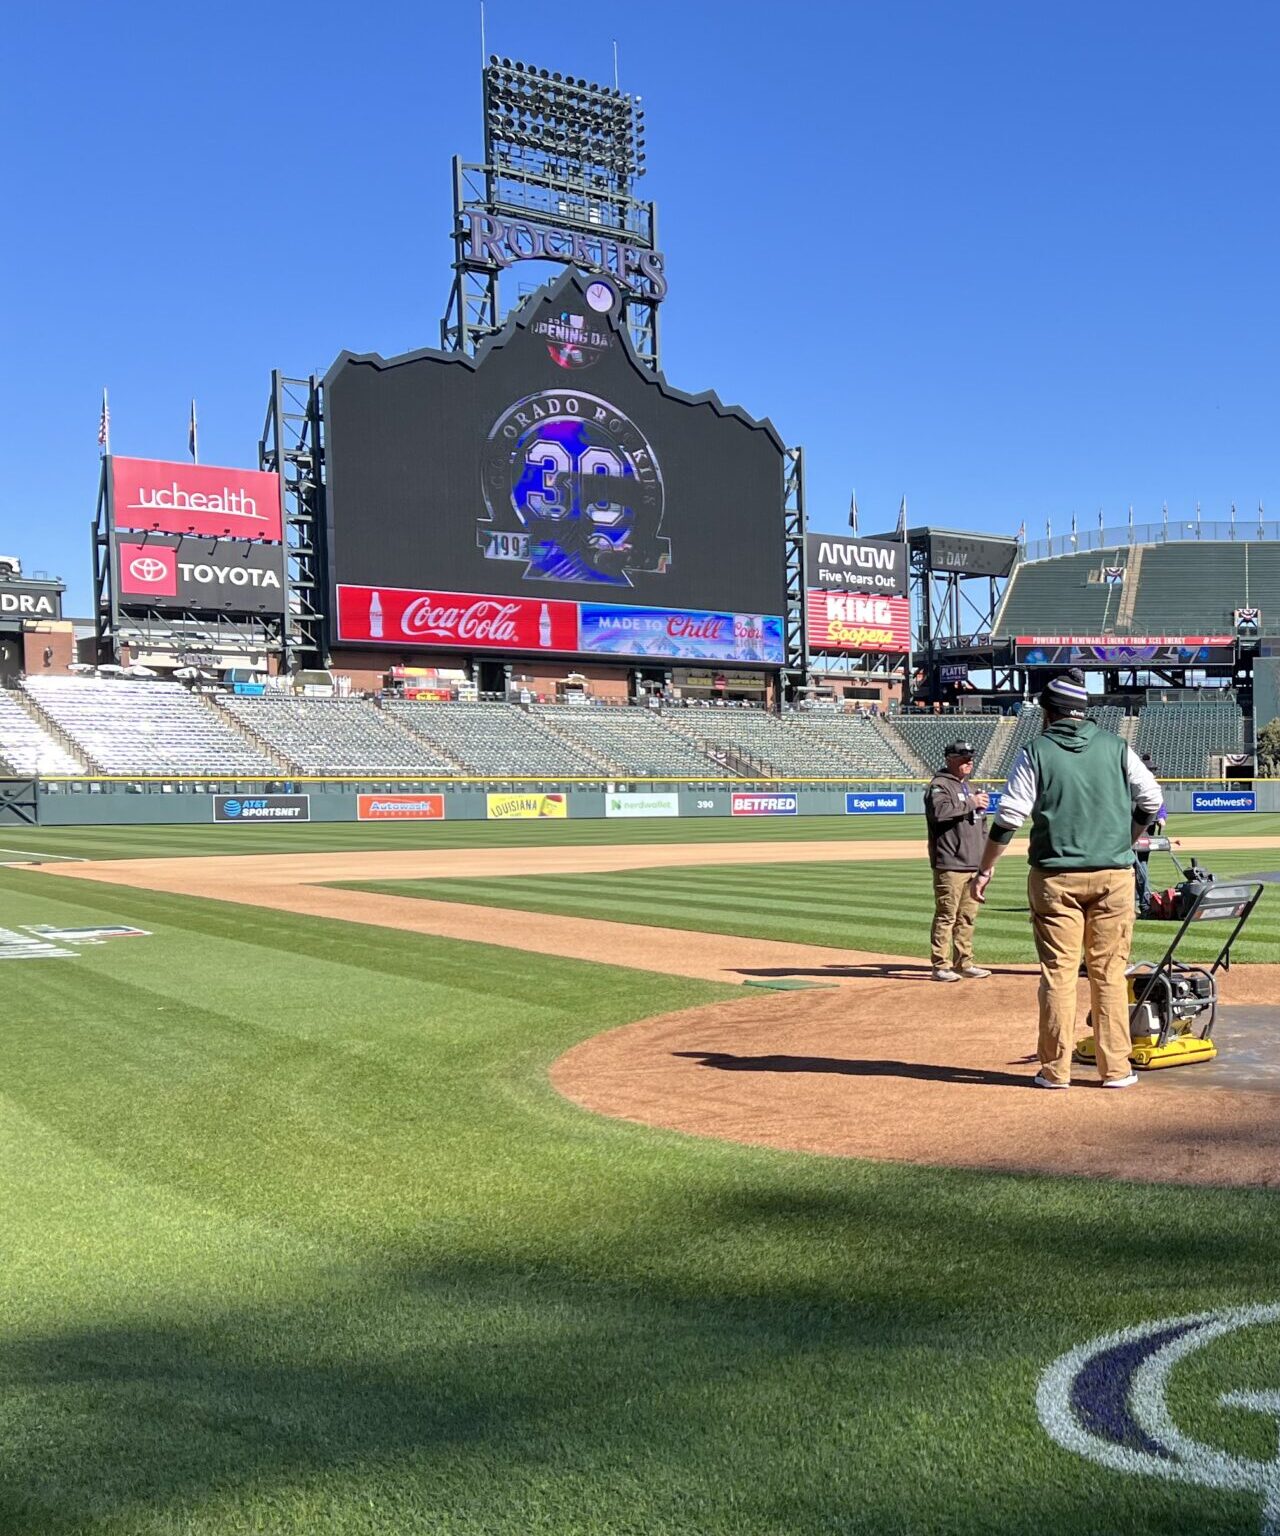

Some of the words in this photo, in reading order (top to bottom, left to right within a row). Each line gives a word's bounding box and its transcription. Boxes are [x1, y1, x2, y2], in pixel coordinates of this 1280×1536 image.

[464, 208, 668, 301] ROCKIES
[138, 482, 257, 517] uchealth
[817, 542, 896, 570] ARROW
[178, 562, 281, 589] TOYOTA
[819, 569, 843, 583] Five
[843, 571, 874, 586] Years
[876, 574, 896, 588] Out
[1, 593, 53, 613] DRA
[826, 597, 892, 624] KING
[401, 597, 522, 642] Coca-Cola
[598, 615, 641, 630] MADE
[646, 618, 663, 632] TO
[665, 614, 724, 640] Chill
[826, 620, 894, 647] Soopers
[941, 666, 967, 676] PLATTE
[241, 807, 301, 817] SPORTSNET
[242, 800, 268, 808] AT&T
[370, 801, 430, 811] Autowash
[490, 799, 538, 818] LOUISIANA
[624, 800, 673, 810] nerdwallet
[697, 800, 714, 809] 390
[733, 798, 796, 811] BETFRED
[853, 799, 875, 810] Exxon
[877, 799, 898, 808] Mobil
[1195, 797, 1246, 808] Southwest
